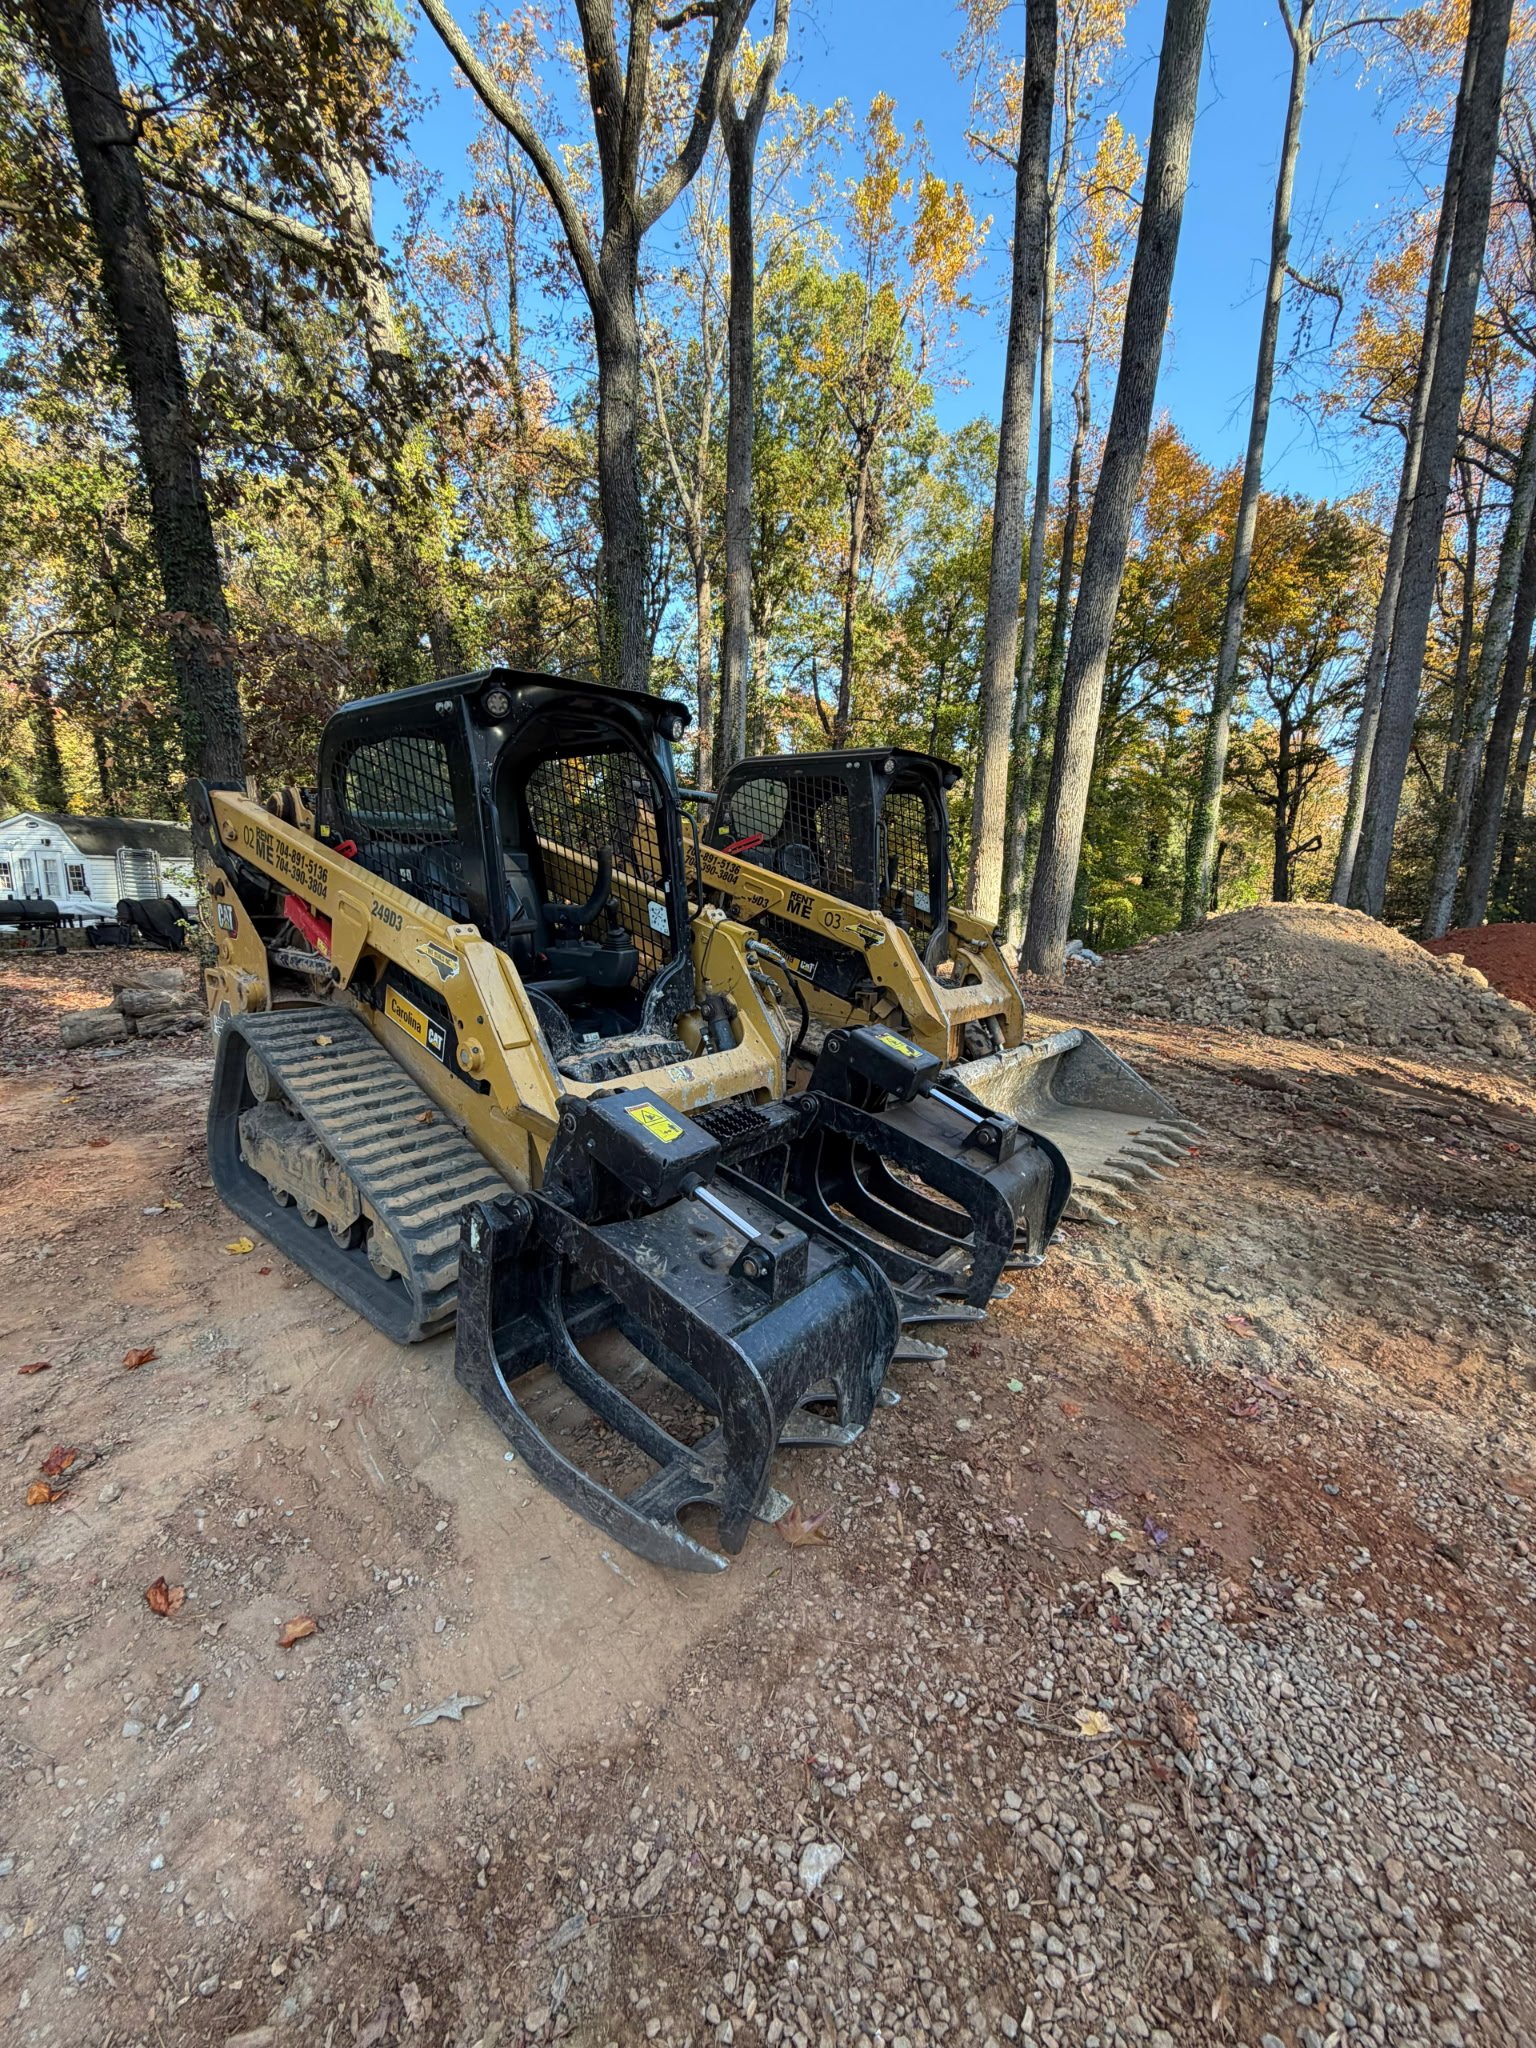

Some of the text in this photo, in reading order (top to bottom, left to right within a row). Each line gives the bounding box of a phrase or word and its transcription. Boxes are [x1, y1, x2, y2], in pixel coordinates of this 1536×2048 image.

[243, 825, 255, 849] 02
[255, 826, 274, 845] RENT
[255, 838, 274, 866] ME
[275, 839, 328, 883] 704-891-5136
[686, 845, 742, 875] 70-891-5136
[275, 855, 328, 900] 704-390-3804
[684, 855, 739, 885] 70390-3804
[786, 899, 813, 919] ME
[789, 890, 816, 907] RENT
[217, 903, 234, 931] CAT
[371, 900, 403, 932] 249D3
[824, 911, 842, 930] 03
[799, 960, 816, 974] CAT
[391, 998, 443, 1051] Carolina CAT
